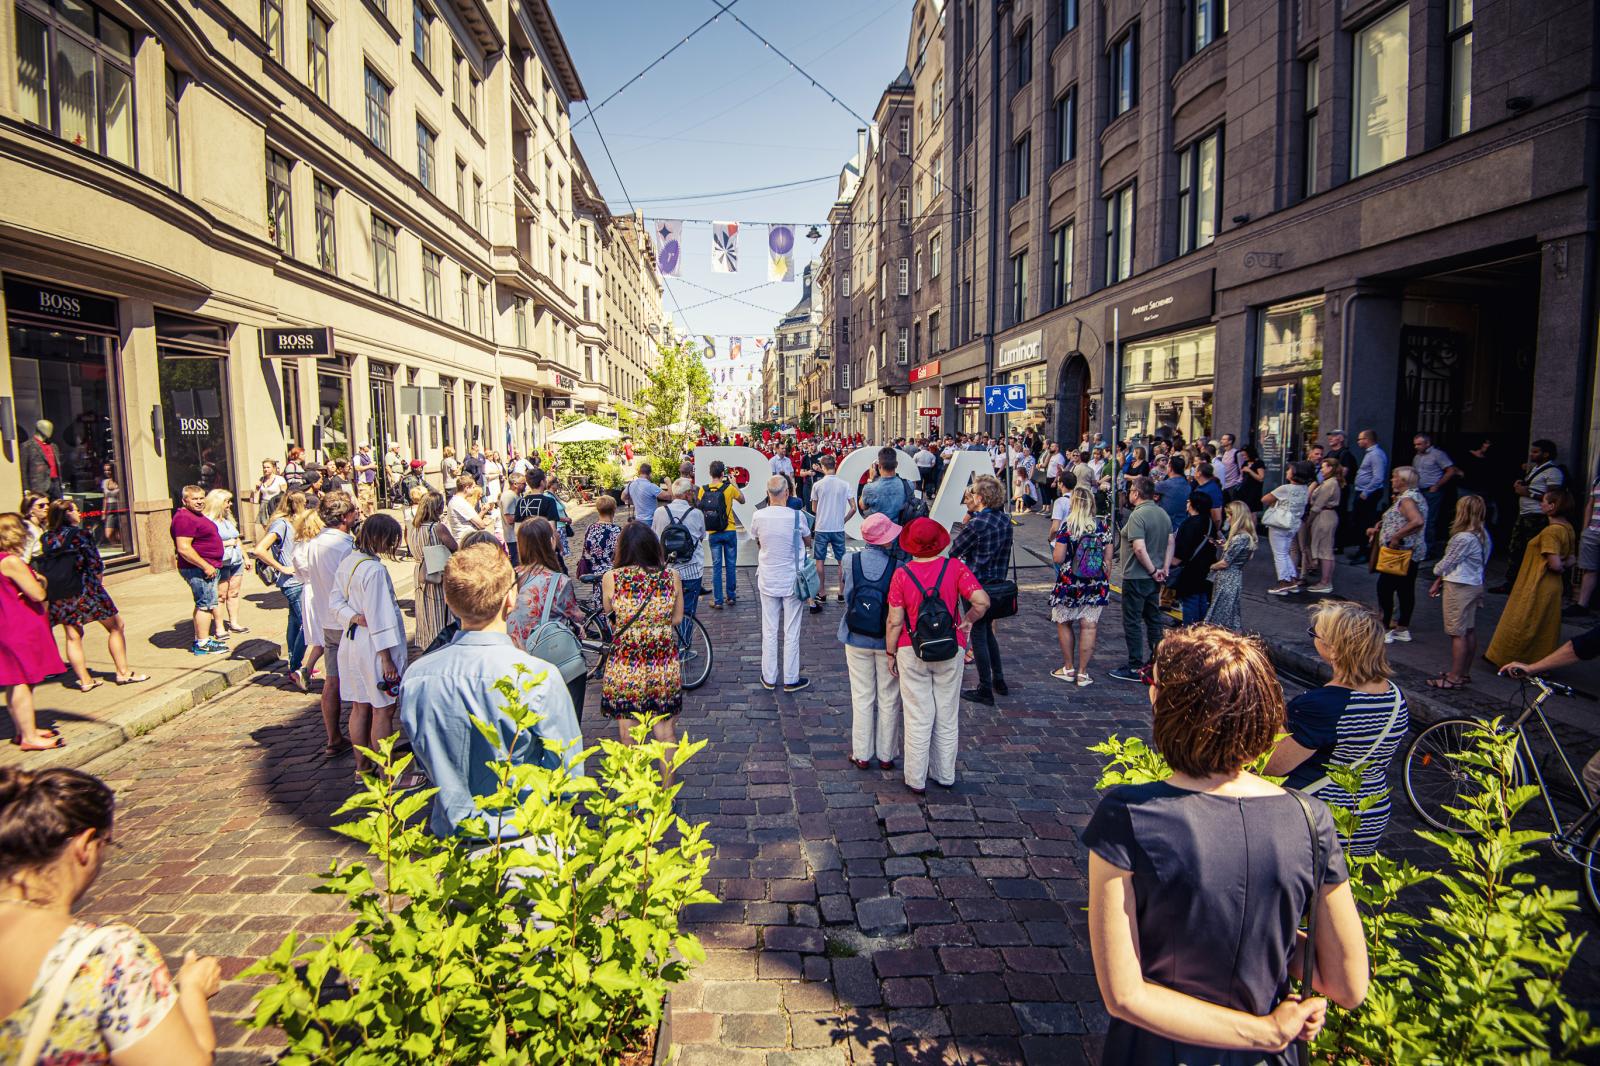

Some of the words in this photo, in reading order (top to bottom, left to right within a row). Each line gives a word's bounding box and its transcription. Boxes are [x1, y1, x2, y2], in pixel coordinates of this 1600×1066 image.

[40, 291, 80, 312] BOSS
[279, 334, 314, 345] BOSS
[999, 339, 1040, 367] Luminor
[180, 418, 209, 431] BOSS
